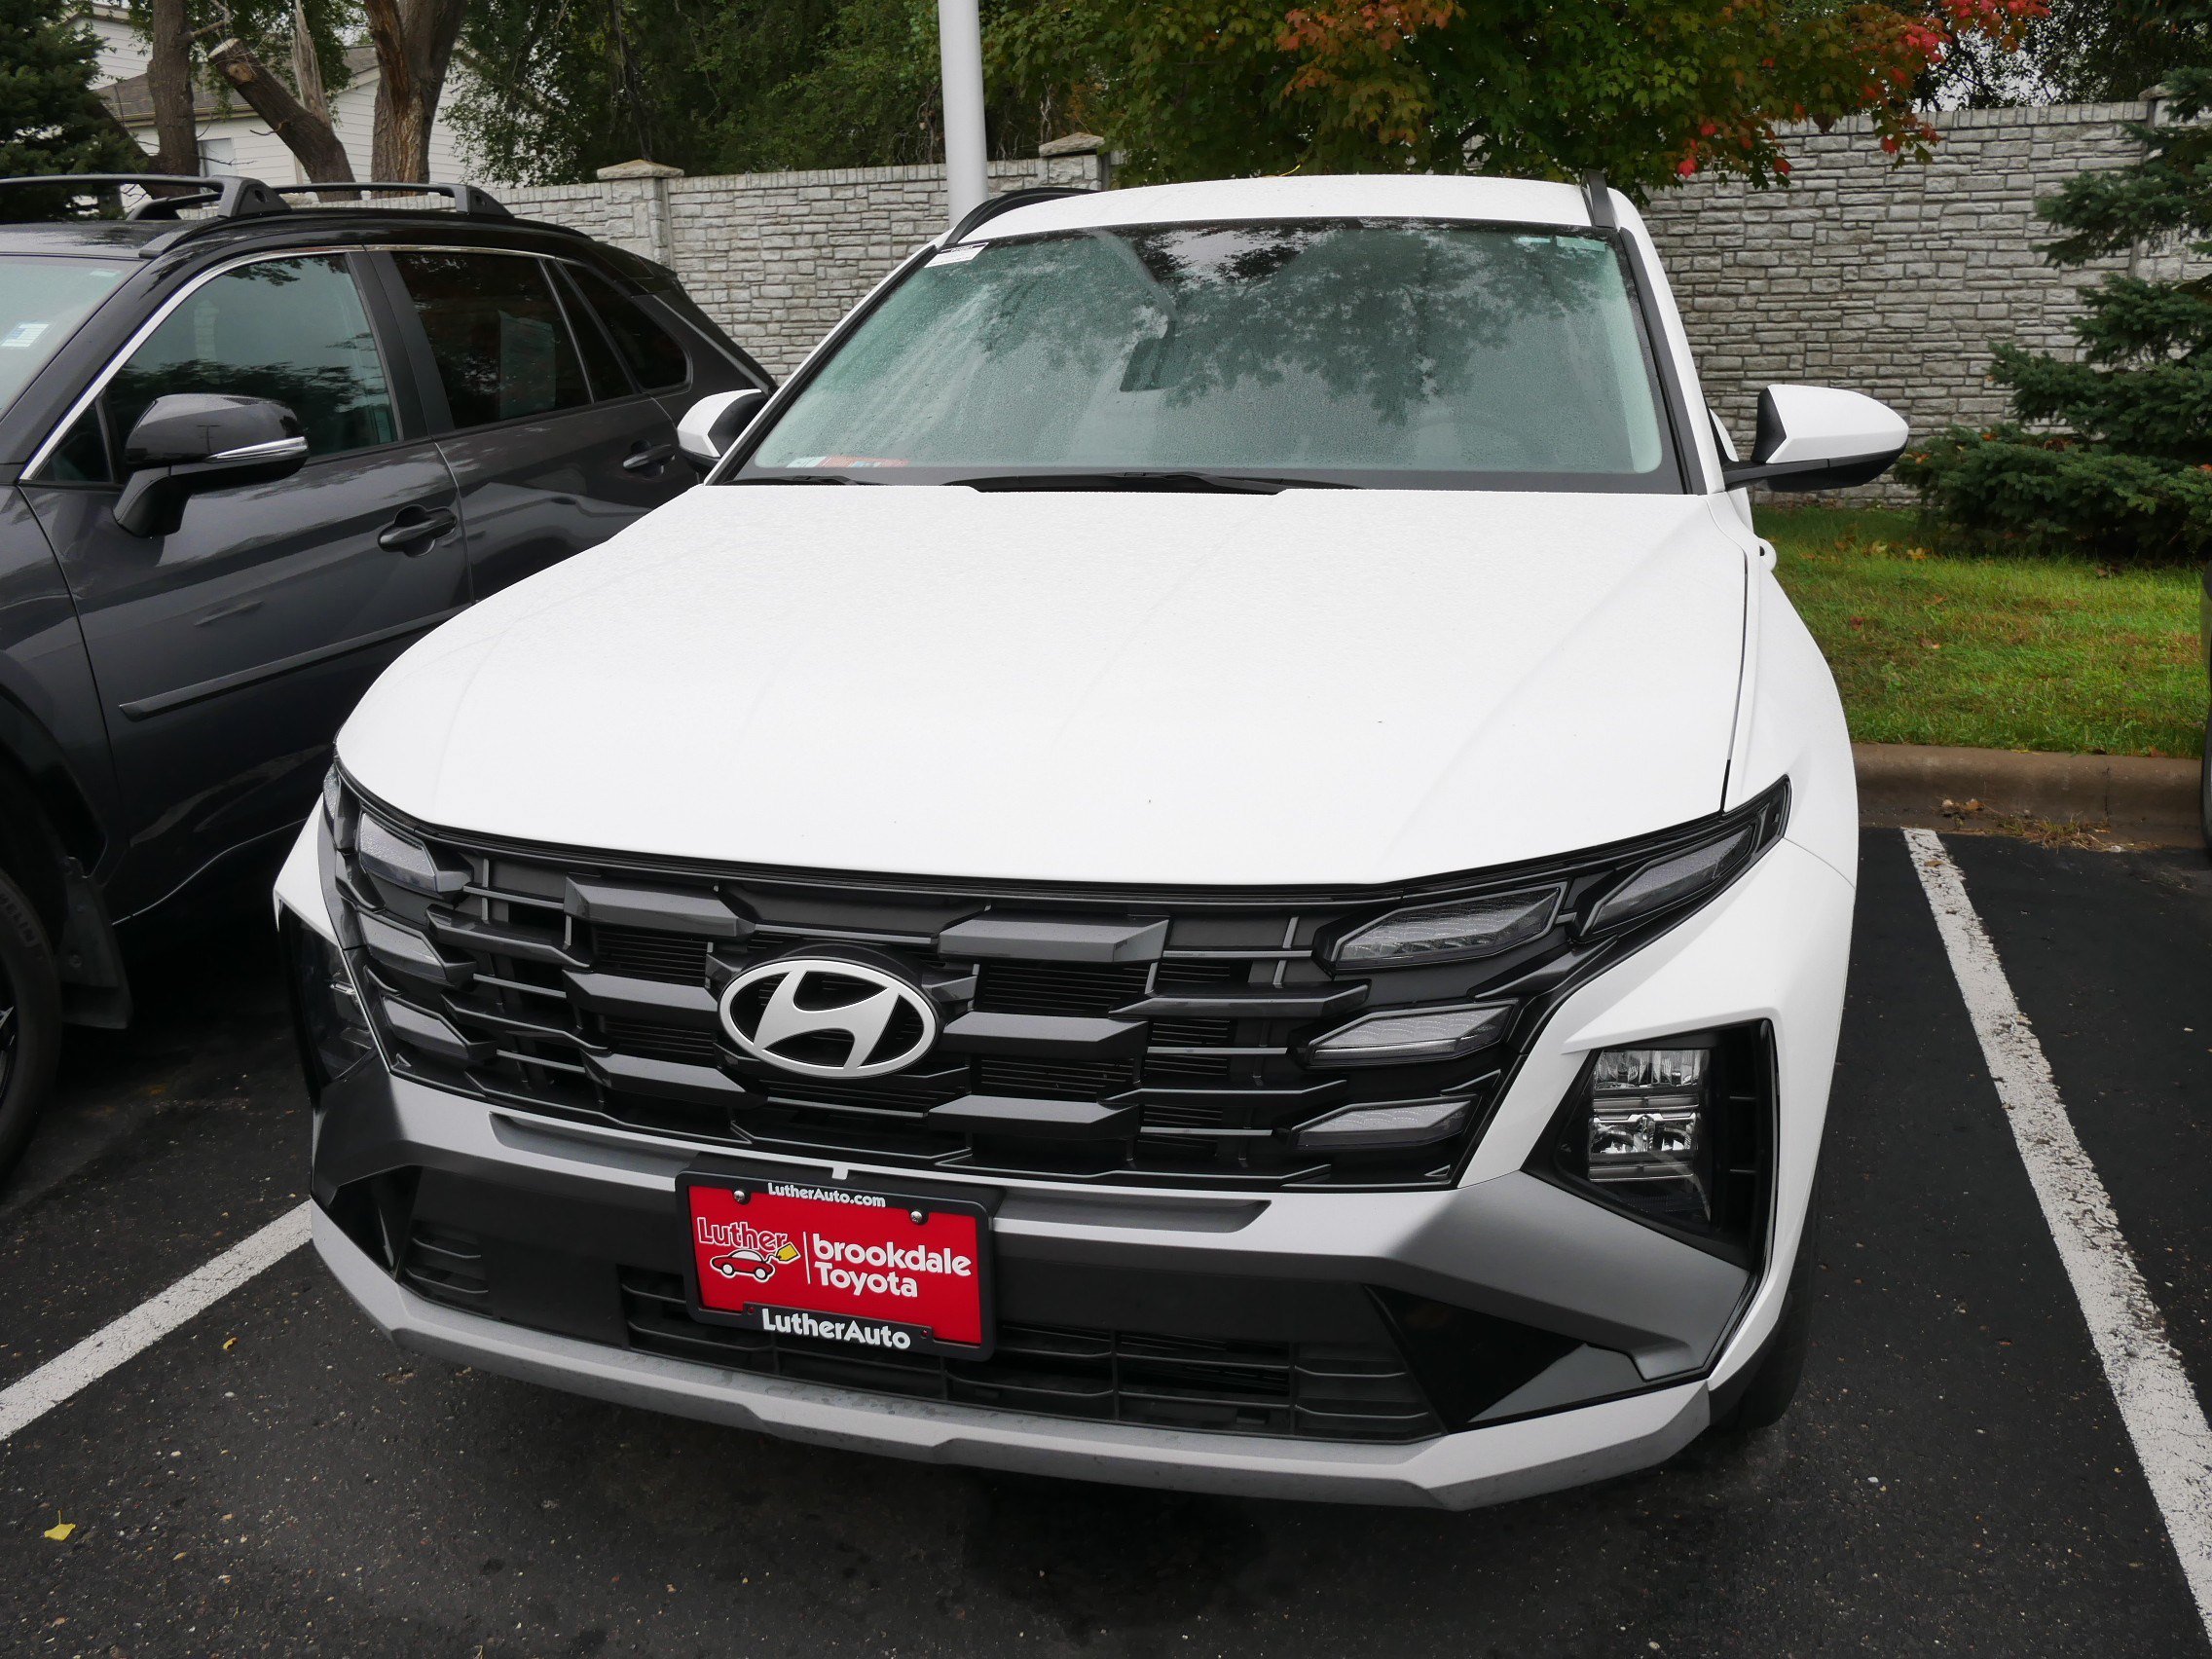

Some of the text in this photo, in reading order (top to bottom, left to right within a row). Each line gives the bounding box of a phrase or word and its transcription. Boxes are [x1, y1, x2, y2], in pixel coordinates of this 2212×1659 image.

[767, 1183, 887, 1208] LutherAuto.com
[697, 1217, 789, 1252] Luther
[812, 1233, 972, 1277] brookdale
[814, 1262, 918, 1298] Toyota
[761, 1308, 911, 1350] LutherAuto
